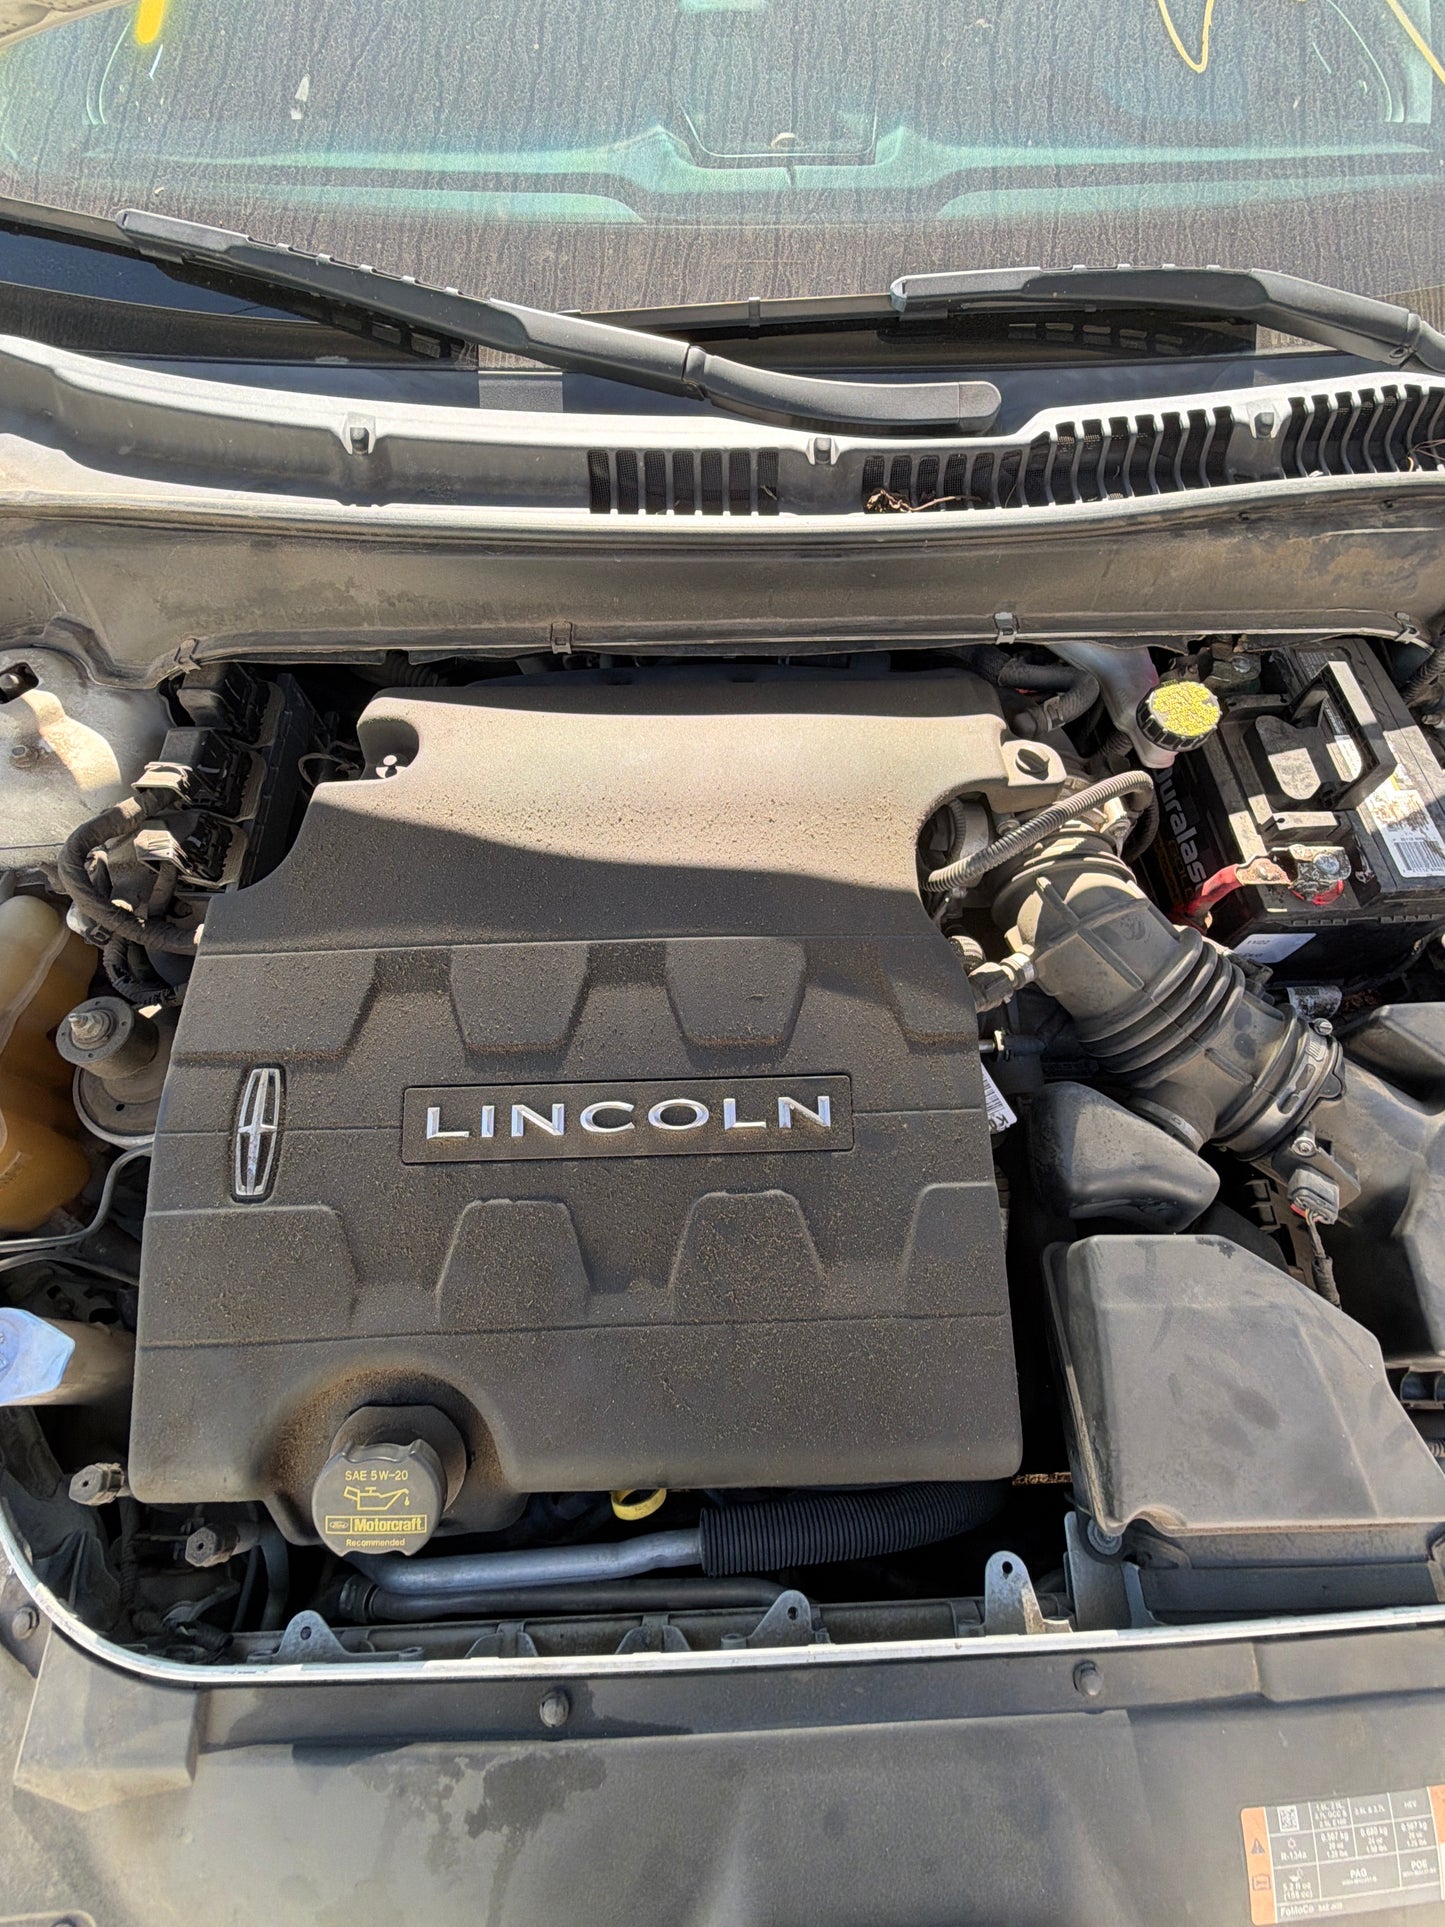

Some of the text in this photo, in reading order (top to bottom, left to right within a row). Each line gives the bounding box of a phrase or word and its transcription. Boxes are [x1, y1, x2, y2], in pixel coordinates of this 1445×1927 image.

[1155, 768, 1207, 889] Duralas
[426, 1095, 831, 1140] LINCOLN
[345, 1470, 409, 1481] SAE 5W-20
[354, 1517, 422, 1532] Motorcraft
[346, 1538, 406, 1547] Recommended
[1280, 1904, 1315, 1917] FoMoCo
